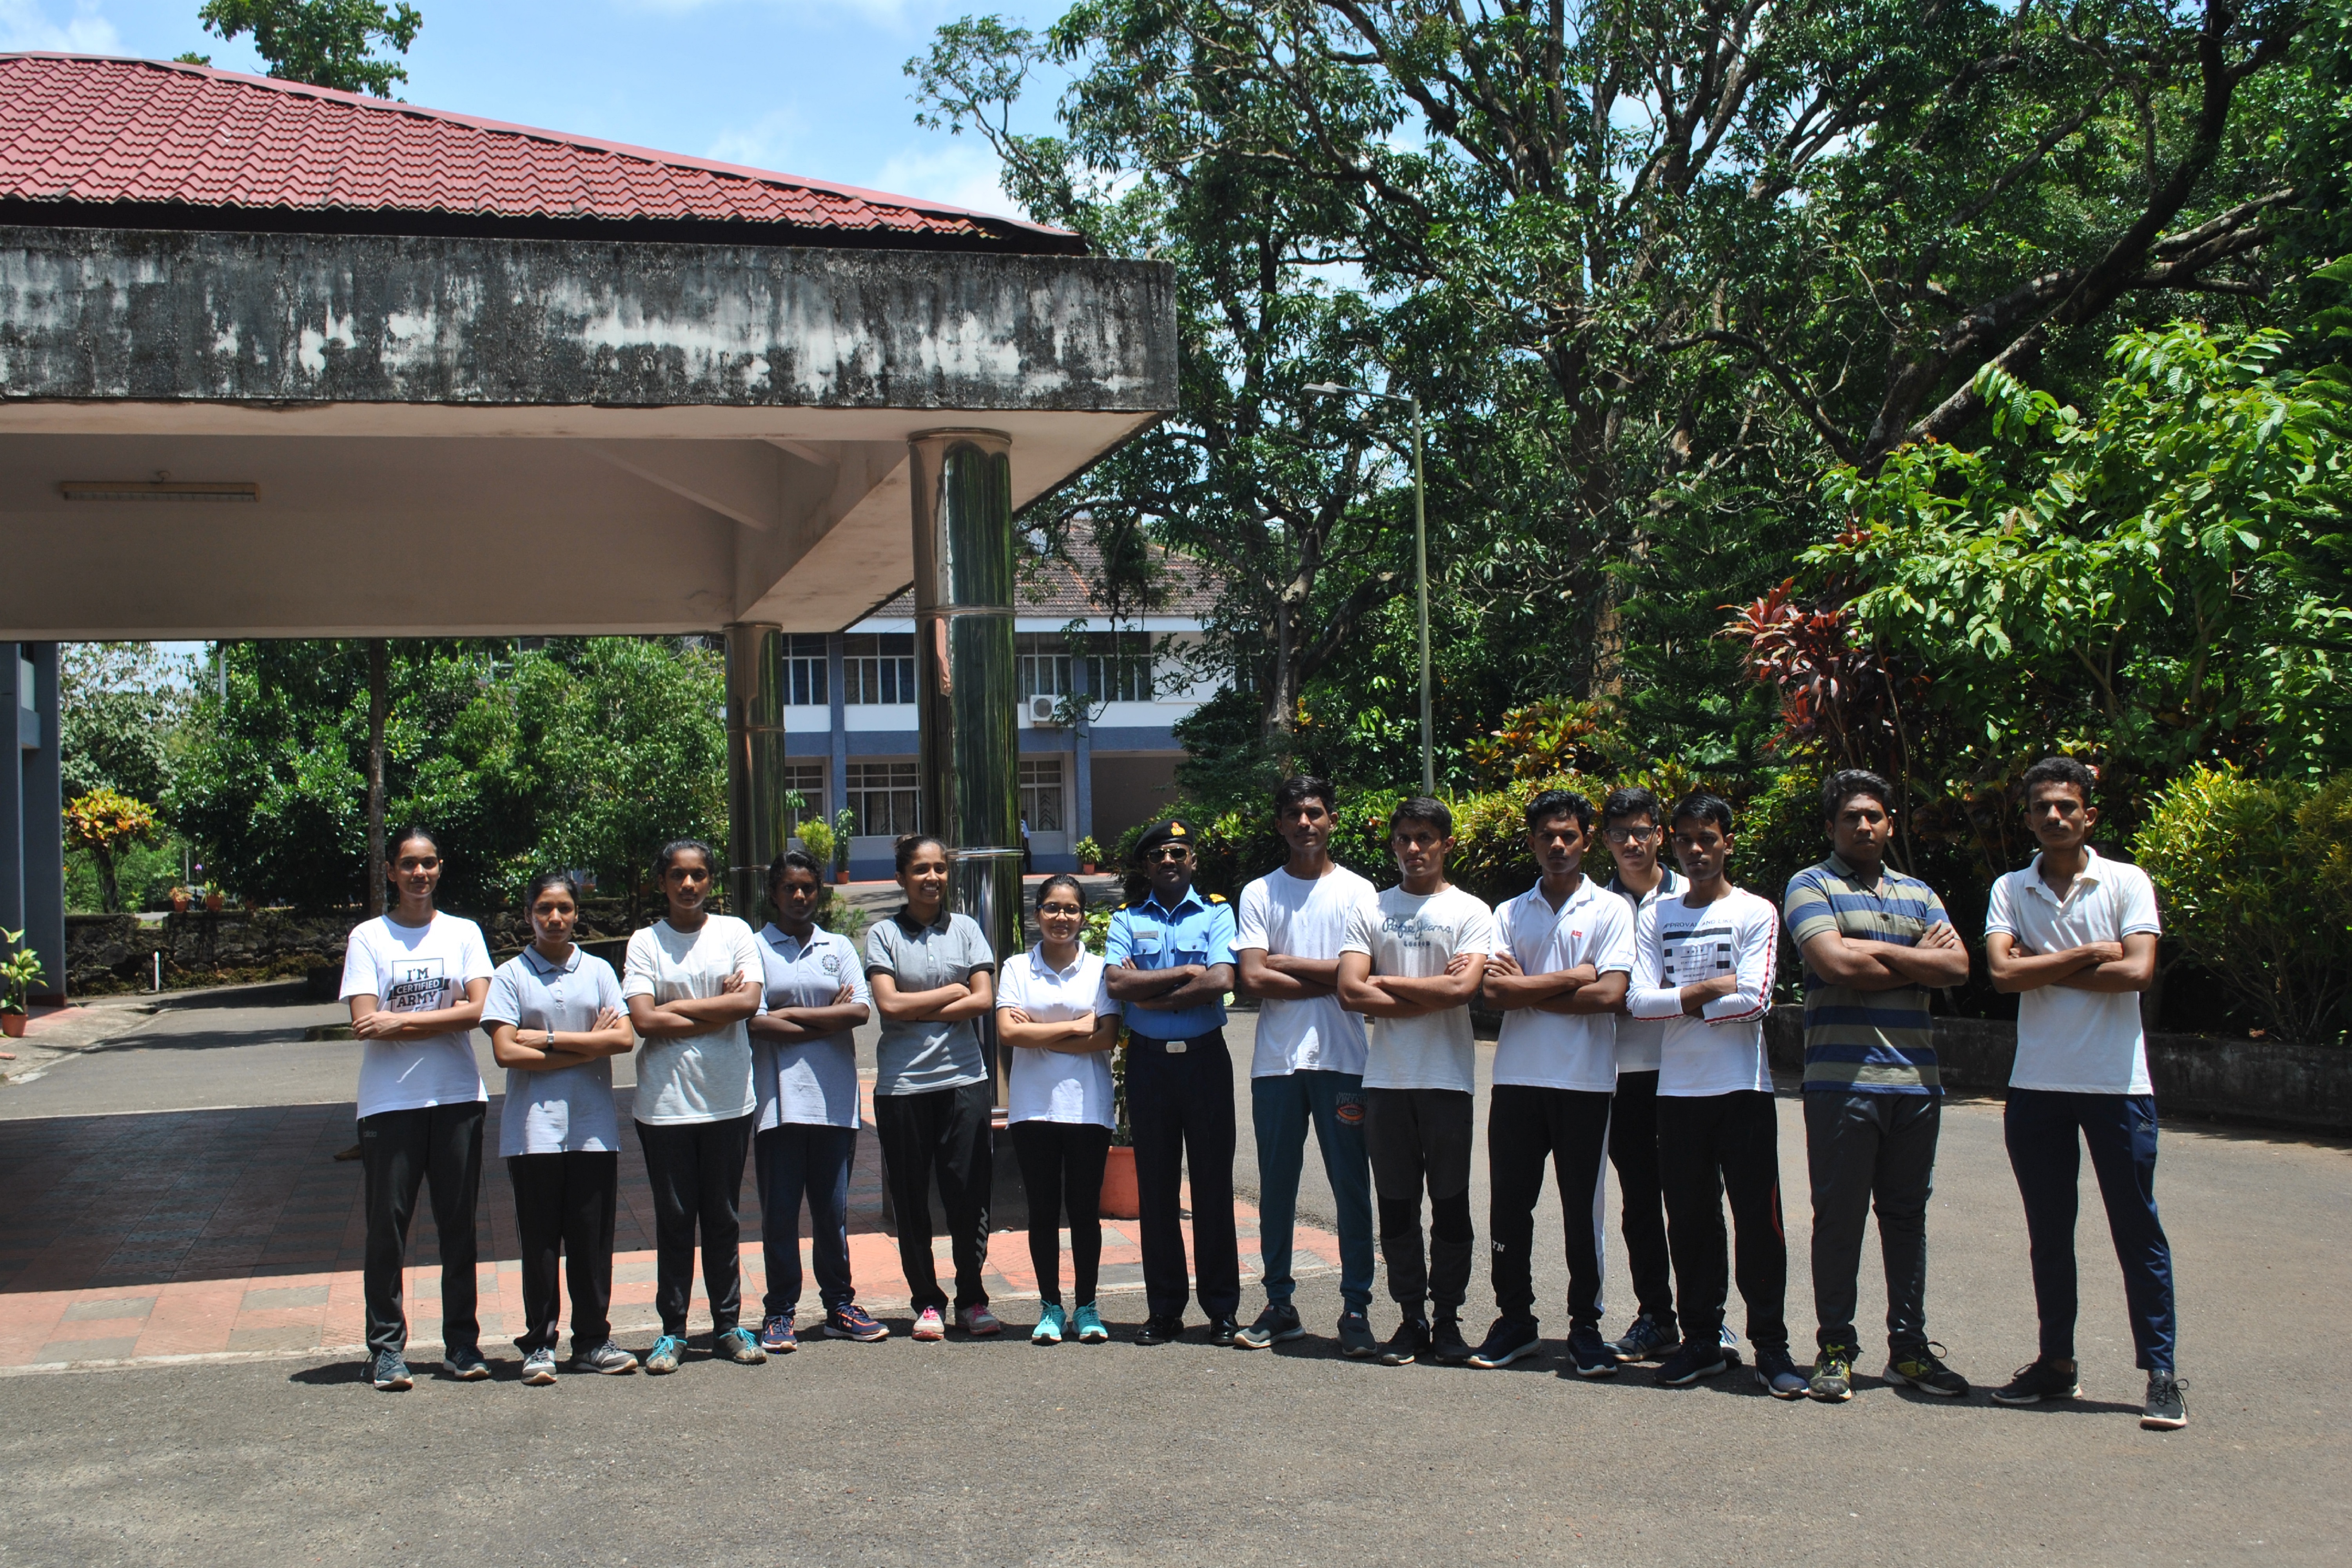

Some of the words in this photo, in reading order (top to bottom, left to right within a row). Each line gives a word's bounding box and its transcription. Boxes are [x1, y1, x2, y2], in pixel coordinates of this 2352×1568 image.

[1382, 917, 1415, 938] Pepe
[1415, 919, 1453, 940] Jeans
[407, 967, 429, 982] I'M
[396, 979, 440, 994] CERTIFIED
[396, 991, 438, 1008] ARMY
